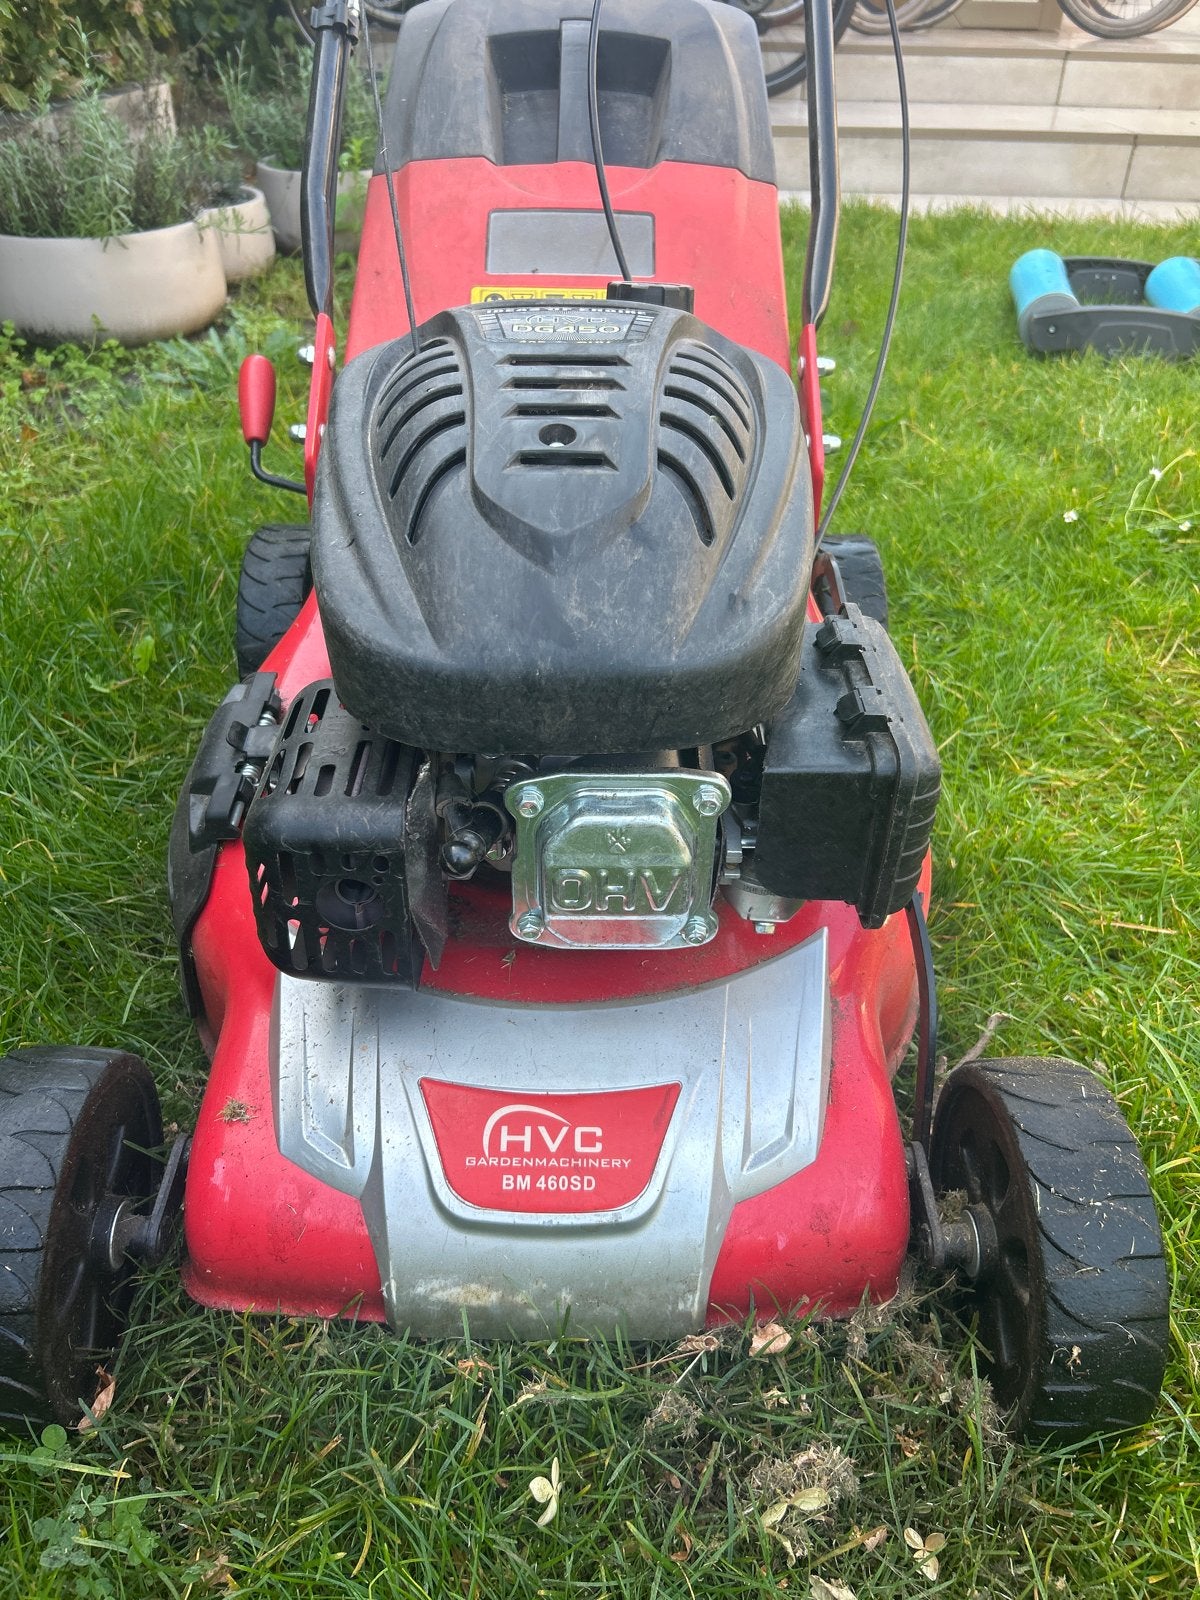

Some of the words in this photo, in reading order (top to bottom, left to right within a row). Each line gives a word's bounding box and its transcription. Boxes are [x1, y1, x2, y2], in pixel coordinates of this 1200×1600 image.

[511, 324, 620, 334] DG450
[551, 868, 683, 911] OHV
[499, 1125, 603, 1154] HVC
[465, 1156, 632, 1169] GARDENMACHINERY
[502, 1175, 531, 1191] BM
[536, 1175, 596, 1192] 460SD
